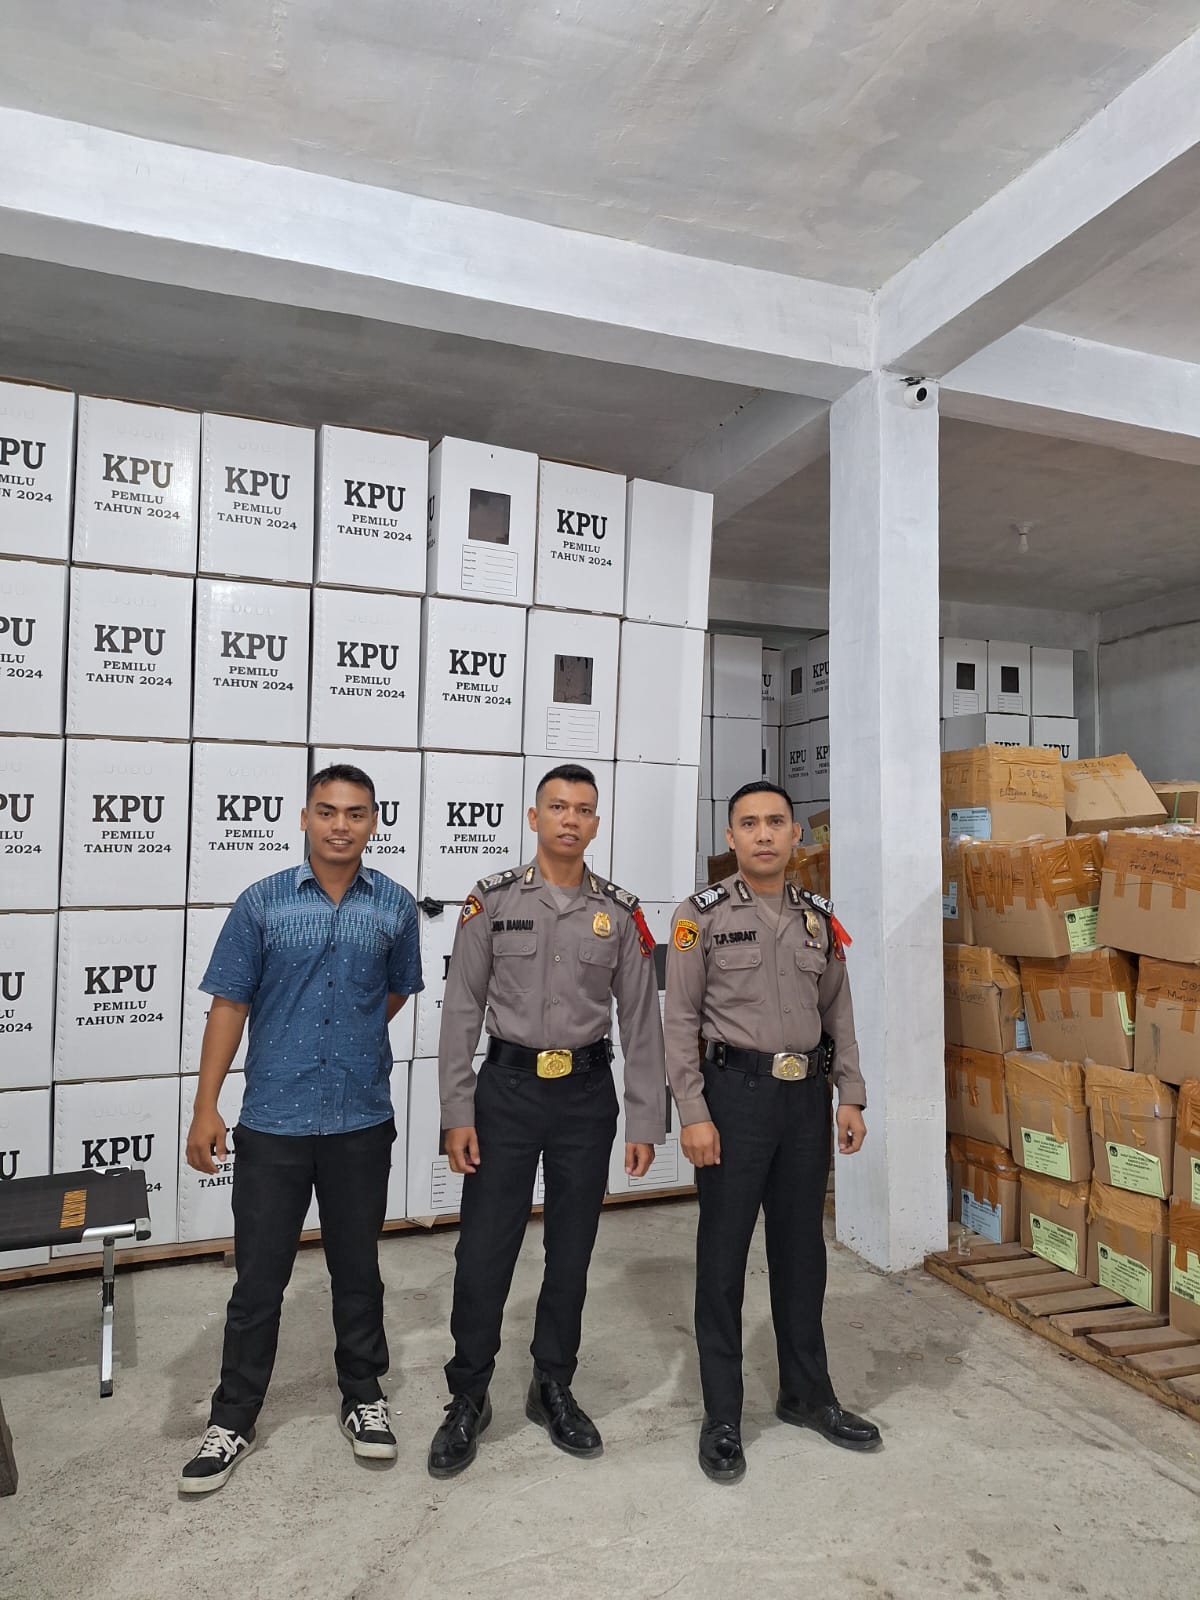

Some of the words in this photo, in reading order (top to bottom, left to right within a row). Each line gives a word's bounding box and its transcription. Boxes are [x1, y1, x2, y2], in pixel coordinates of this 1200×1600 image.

[0, 437, 46, 469] PU
[103, 453, 173, 488] KPU
[0, 474, 35, 486] MILU
[225, 466, 290, 500] KPU
[17, 490, 53, 502] 2024
[112, 490, 163, 504] PEMILU
[344, 480, 406, 512] KPU
[94, 501, 141, 515] TAHUN
[147, 508, 180, 519] 2024
[233, 502, 281, 515] PEMILU
[217, 512, 261, 525] TAHUN
[267, 519, 297, 530] 2024
[352, 514, 397, 527] PEMILU
[557, 509, 607, 539] KPU
[337, 525, 379, 537] TAHUN
[384, 531, 412, 541] 2024
[563, 541, 600, 553] PEMILU
[551, 551, 585, 562] TAHUN
[589, 557, 612, 566] 2024
[94, 624, 166, 655] KPU
[221, 631, 287, 661] KPU
[0, 654, 24, 663] ILU
[337, 641, 399, 670] KPU
[104, 661, 156, 671] PEMILU
[449, 649, 506, 678] KPU
[7, 668, 43, 678] 2024
[229, 666, 278, 677] PEMILU
[86, 673, 134, 683] TAHUN
[140, 676, 172, 686] 2024
[213, 677, 258, 688] TAHUN
[263, 681, 294, 690] 2024
[345, 675, 390, 685] PEMILU
[330, 687, 372, 696] TAHUN
[377, 689, 405, 698] 2024
[457, 682, 498, 692] PEMILU
[442, 693, 481, 703] TAHUN
[485, 696, 511, 705] 2024
[790, 750, 806, 764] KPU
[816, 746, 829, 760] KP
[92, 795, 164, 823] KPU
[217, 795, 283, 822] KPU
[447, 802, 504, 827] KPU
[0, 831, 23, 839] ILU
[102, 831, 154, 839] PEMILU
[225, 829, 274, 838] PEMILU
[368, 833, 392, 842] ILU
[454, 834, 495, 842] PEMILU
[5, 845, 42, 853] 2024
[84, 844, 132, 853] TAHUN
[138, 844, 171, 852] 2024
[209, 842, 253, 850] TAHUN
[259, 843, 289, 851] 2024
[377, 846, 405, 854] 2024
[440, 846, 478, 854] TAHUN
[482, 846, 509, 854] 2024
[84, 965, 157, 994] KPU
[94, 1001, 146, 1011] PEMILU
[76, 1015, 124, 1026] TAHUN
[130, 1013, 163, 1023] 2024
[0, 1023, 32, 1033] 2024
[82, 1134, 154, 1168] KPU
[145, 1182, 162, 1192] 24
[198, 1176, 234, 1188] TAHU
